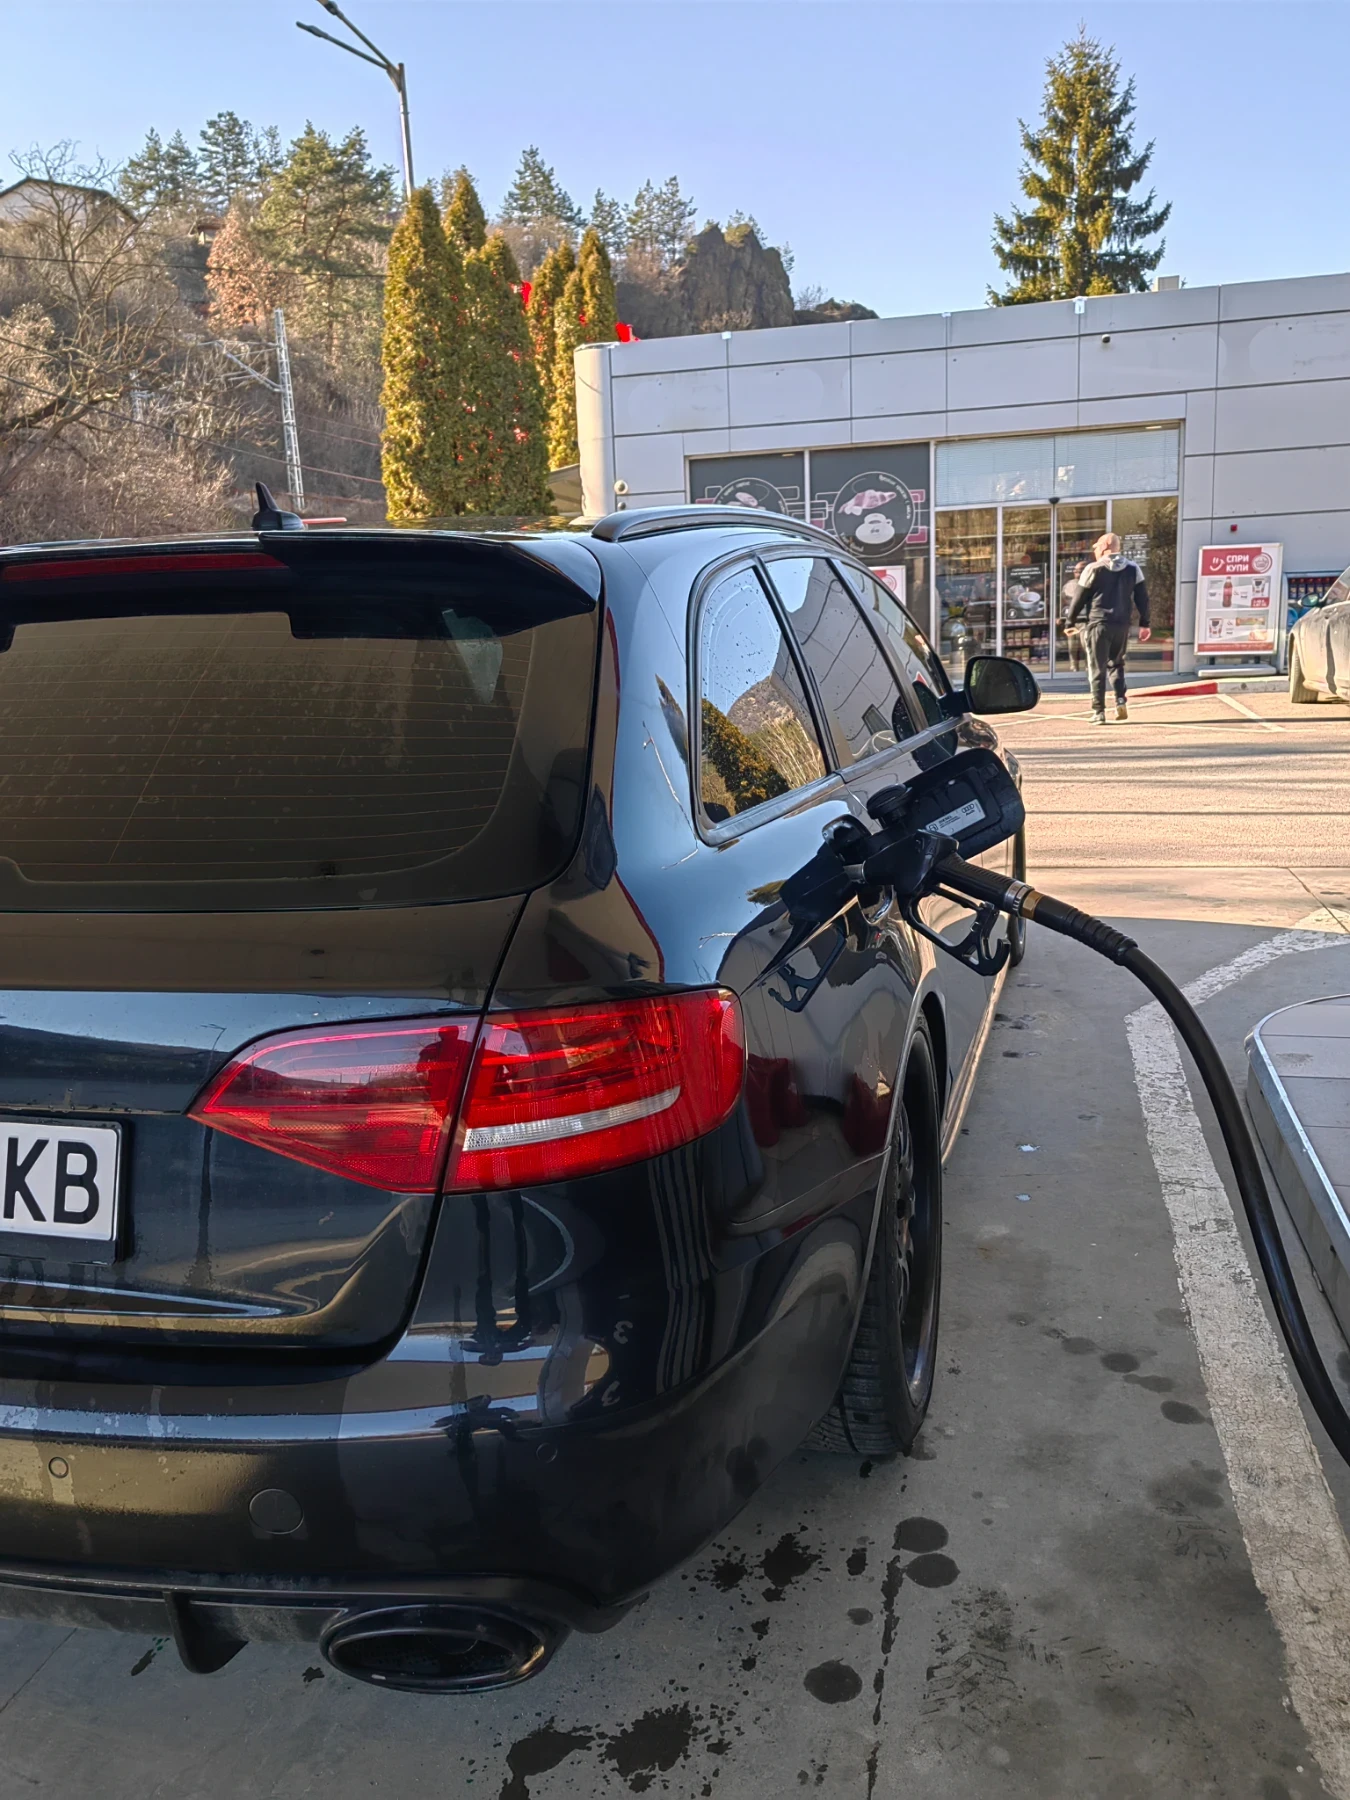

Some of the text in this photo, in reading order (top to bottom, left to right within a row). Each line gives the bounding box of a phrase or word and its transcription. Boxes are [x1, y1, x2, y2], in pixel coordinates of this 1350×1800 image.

[1226, 554, 1249, 563] СПРИ
[1226, 563, 1249, 572] КУПИ
[3, 1137, 100, 1225] KB
